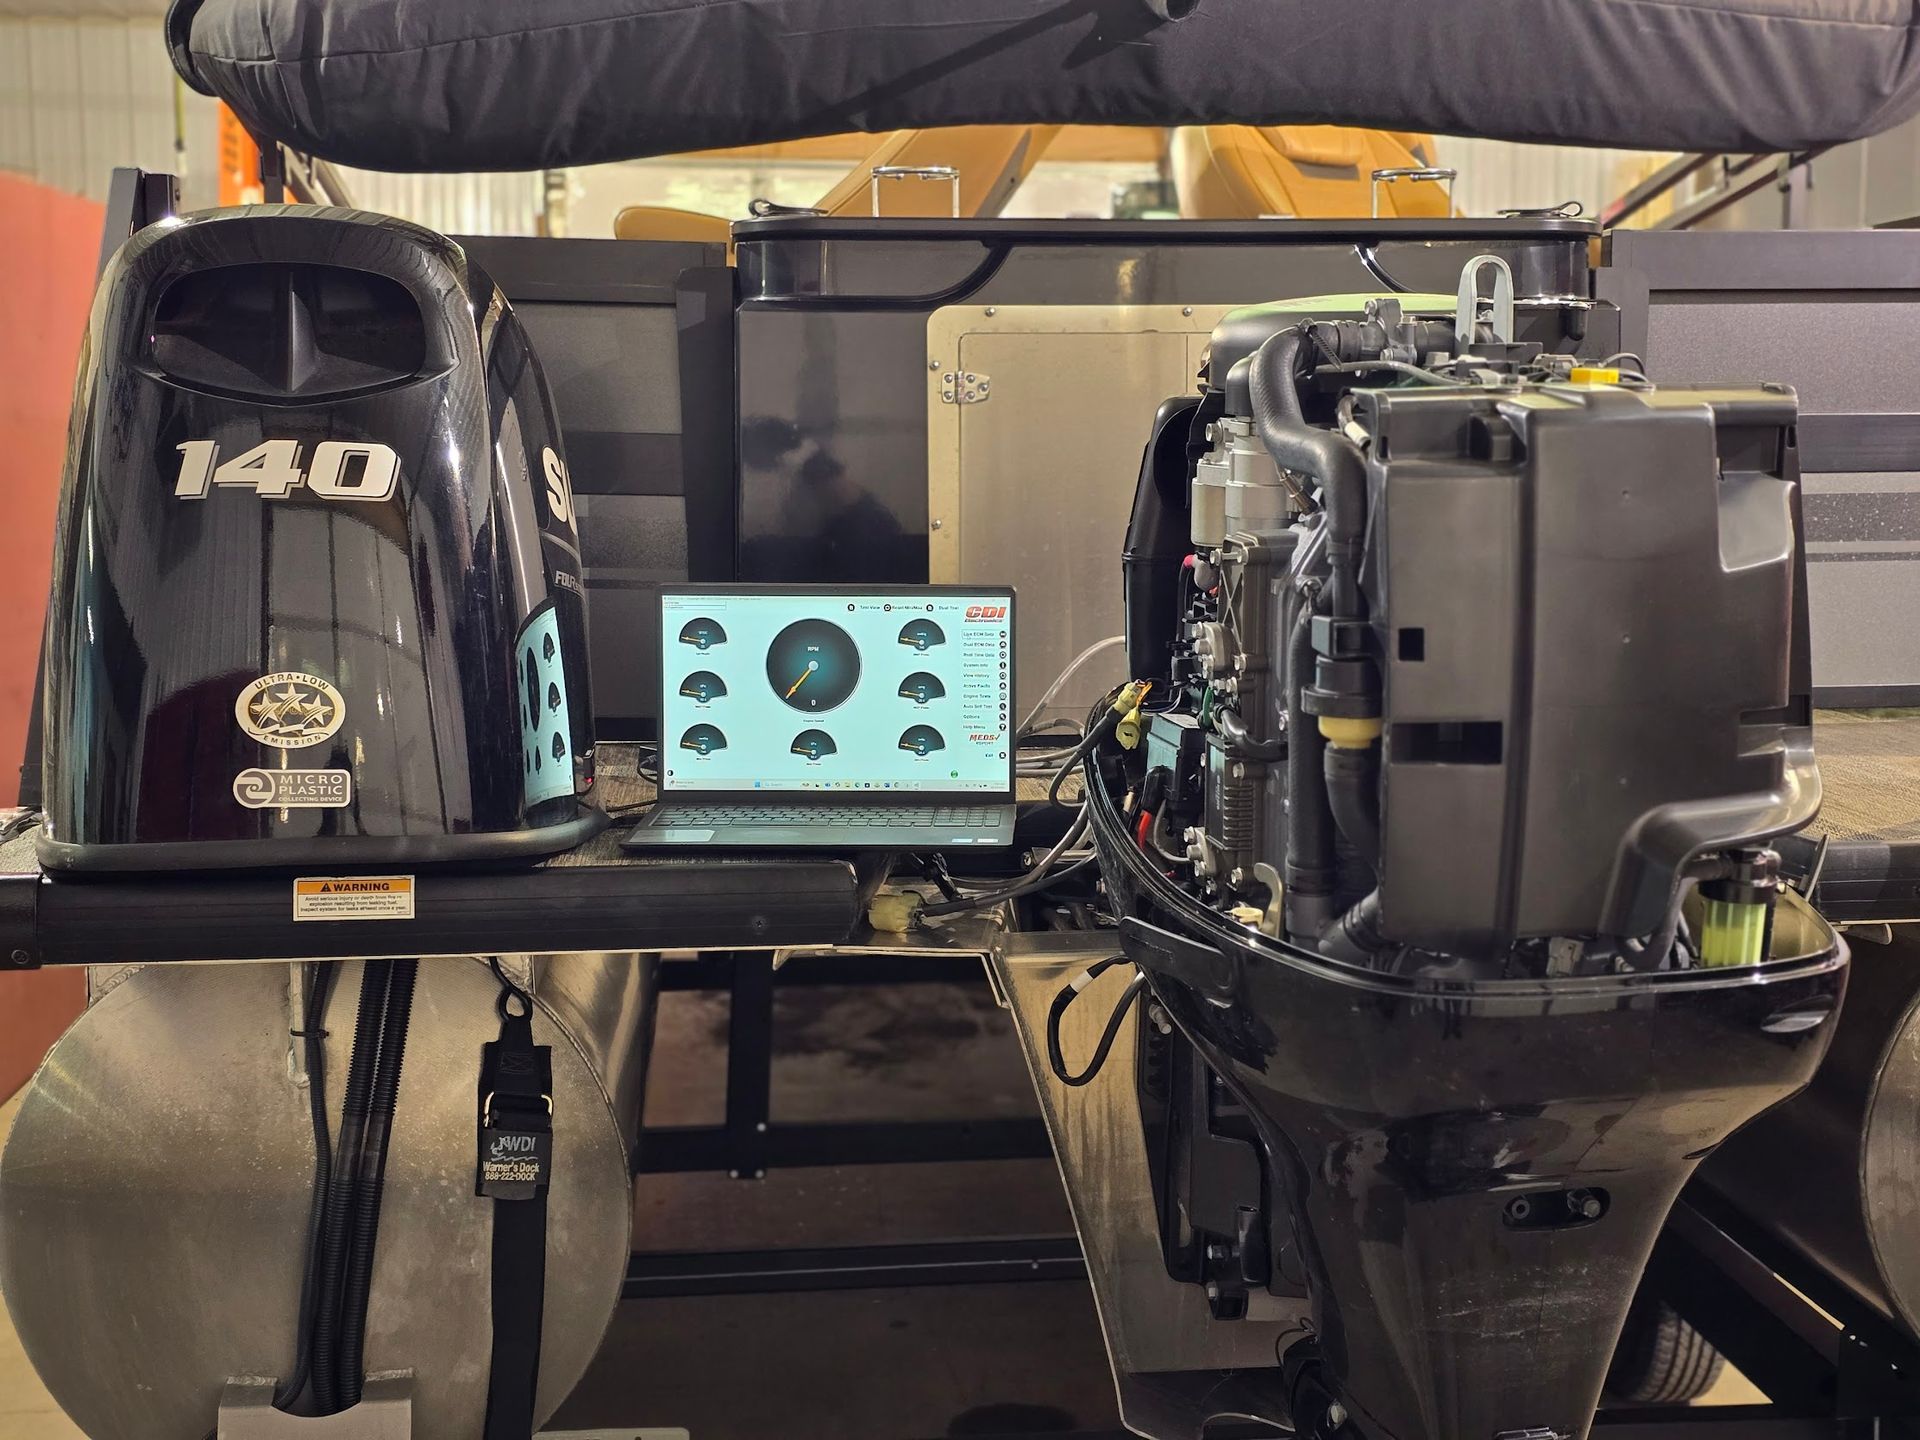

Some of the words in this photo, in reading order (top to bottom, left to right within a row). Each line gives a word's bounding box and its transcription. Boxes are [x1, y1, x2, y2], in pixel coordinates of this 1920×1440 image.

[174, 439, 401, 502] 140
[965, 606, 1007, 618] CDI
[254, 673, 294, 690] ULTRA
[302, 674, 329, 690] LOW
[263, 734, 321, 746] EMISSION
[280, 774, 343, 784] MICRO
[279, 785, 343, 795] PLASTIC
[334, 882, 390, 892] WARNING
[483, 1161, 518, 1171] Warner's
[519, 1162, 540, 1172] Dock
[484, 1172, 536, 1181] 888-222-DOCK
